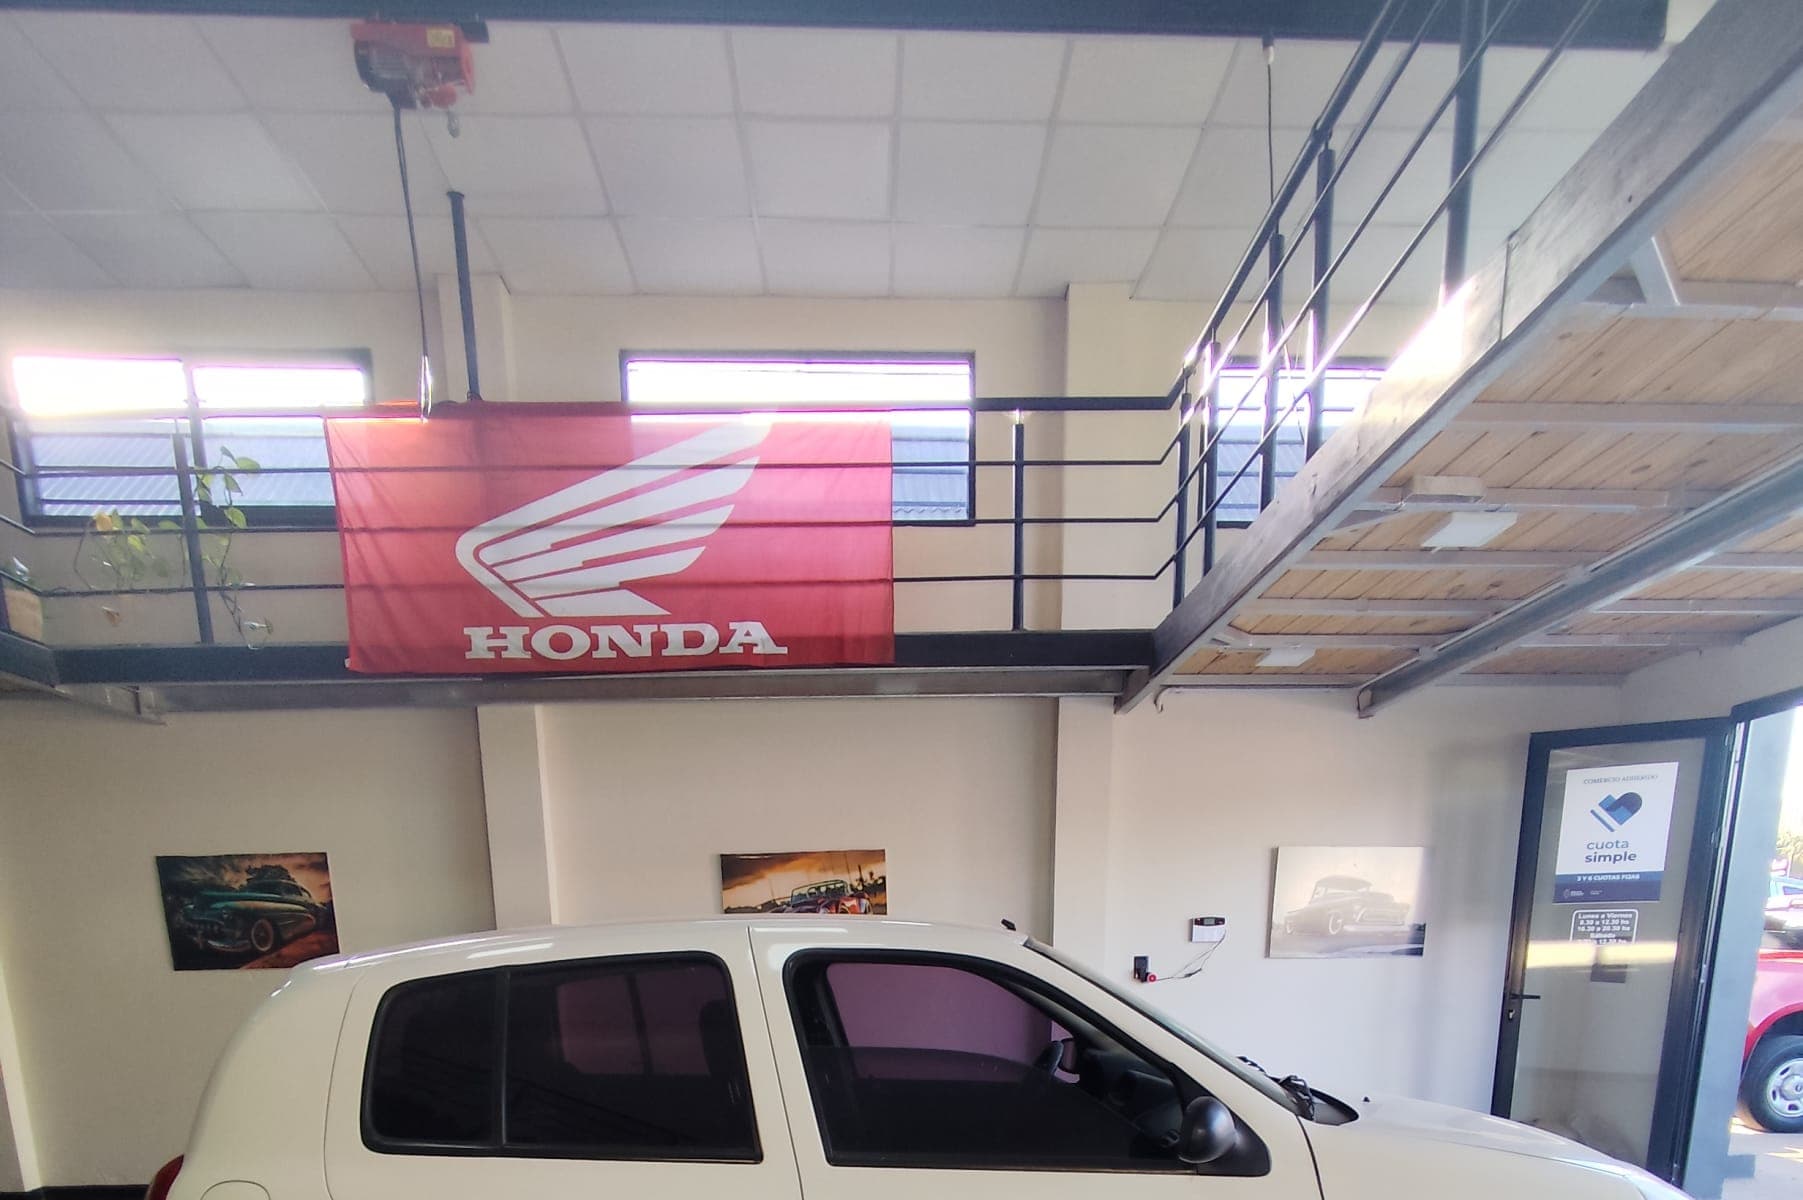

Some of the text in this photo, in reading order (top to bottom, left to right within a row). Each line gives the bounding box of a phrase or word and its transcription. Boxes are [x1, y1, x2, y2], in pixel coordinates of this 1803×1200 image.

[463, 621, 788, 660] HONDA
[1586, 840, 1629, 850] cuota
[1585, 851, 1637, 864] simple
